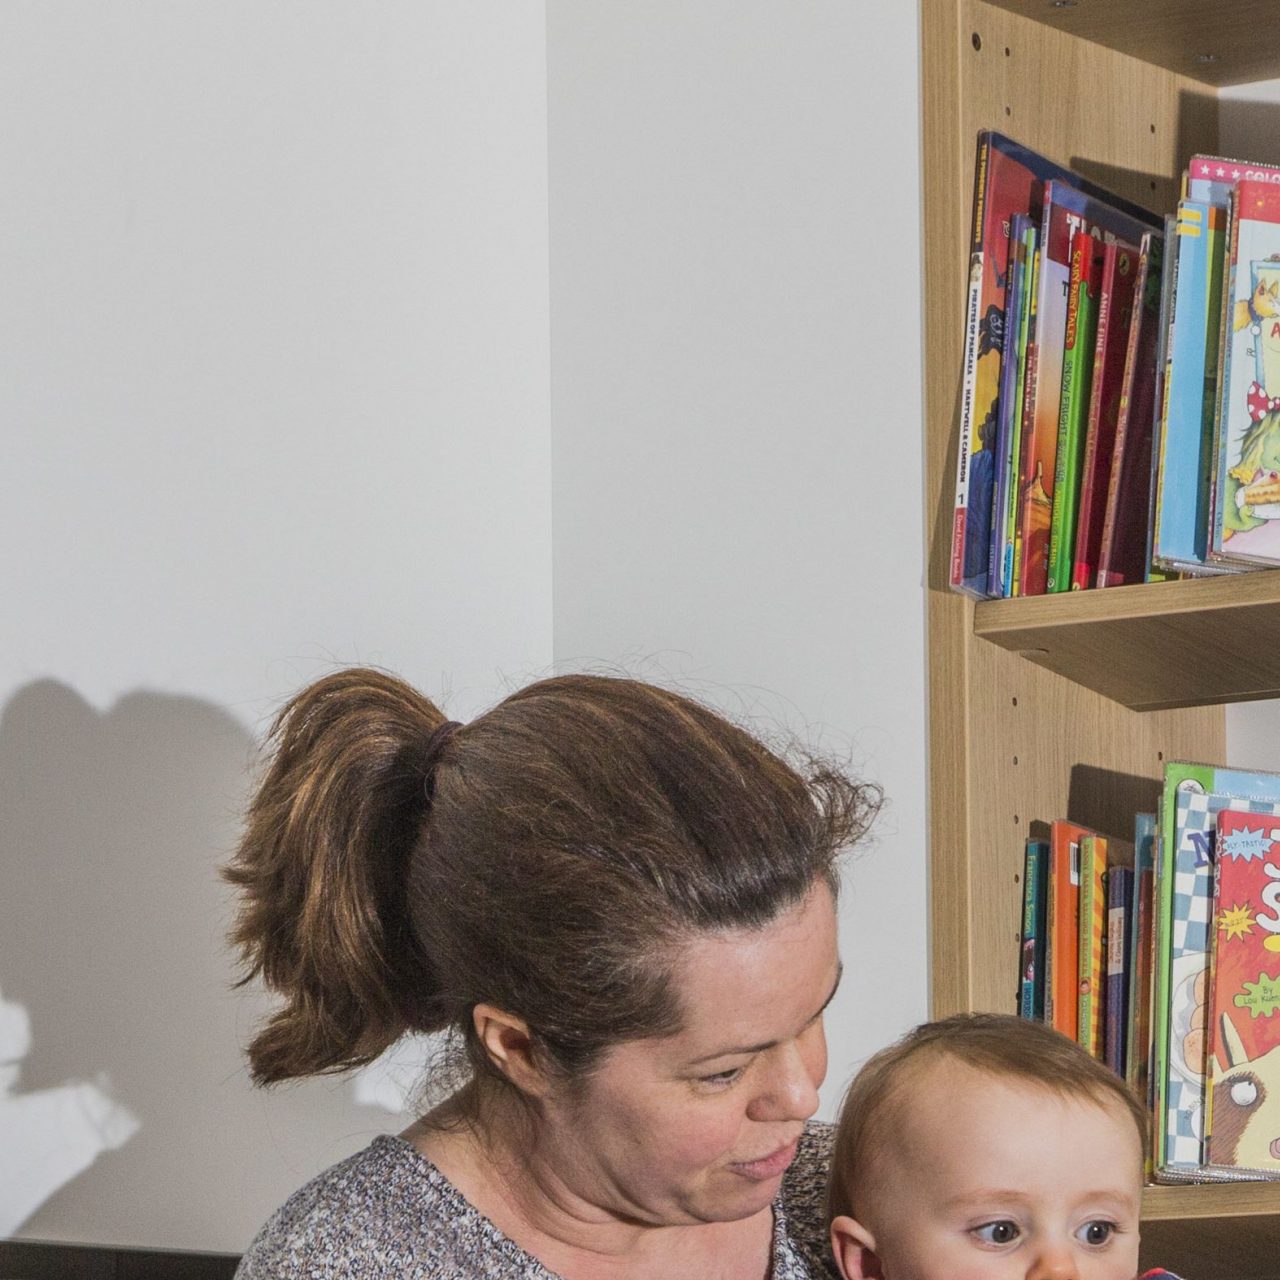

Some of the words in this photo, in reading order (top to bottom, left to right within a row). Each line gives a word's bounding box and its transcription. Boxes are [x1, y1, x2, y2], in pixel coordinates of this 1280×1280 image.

[1072, 250, 1082, 281] SCARY
[970, 288, 979, 322] PIRATES
[1099, 292, 1109, 326] ANNE
[1067, 312, 1077, 344] TALES
[1096, 327, 1105, 354] FINE
[1062, 360, 1073, 394] SNOW
[962, 389, 972, 433] HARTWELL
[1059, 396, 1070, 437] FRIGHT
[959, 441, 968, 483] CAMERON
[1025, 855, 1037, 902] Francesca
[1024, 903, 1035, 934] Simon
[1243, 996, 1259, 1005] Lou
[1262, 986, 1273, 995] By
